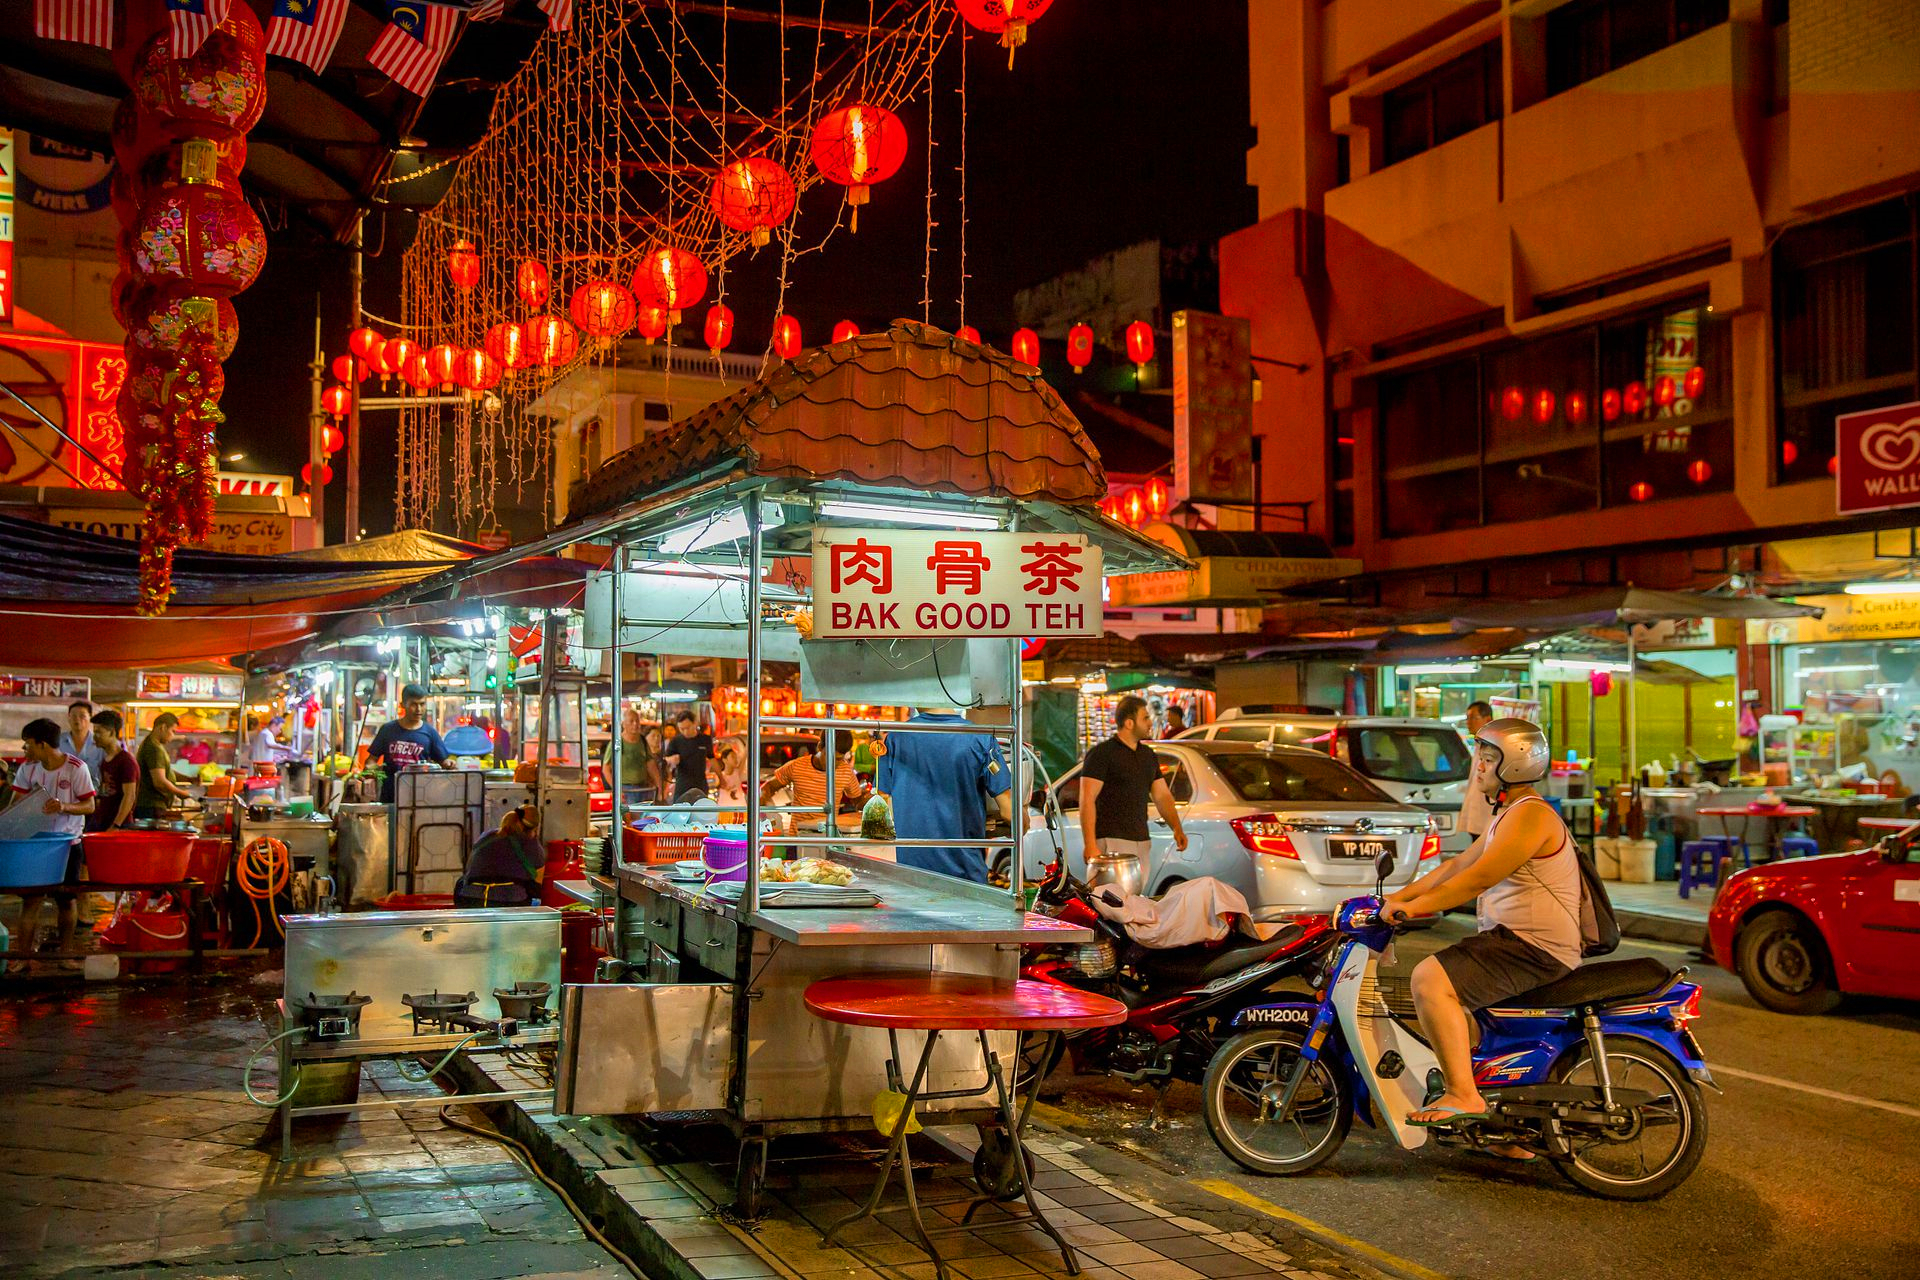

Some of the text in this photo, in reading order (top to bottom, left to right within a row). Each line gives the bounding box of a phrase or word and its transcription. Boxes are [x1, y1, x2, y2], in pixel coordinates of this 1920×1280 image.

[247, 520, 284, 541] City
[830, 537, 1084, 596] 肉骨茶
[832, 603, 1084, 629] BAK GOOD TEH
[1343, 842, 1357, 856] VP
[1246, 1009, 1309, 1023] WYH2004
